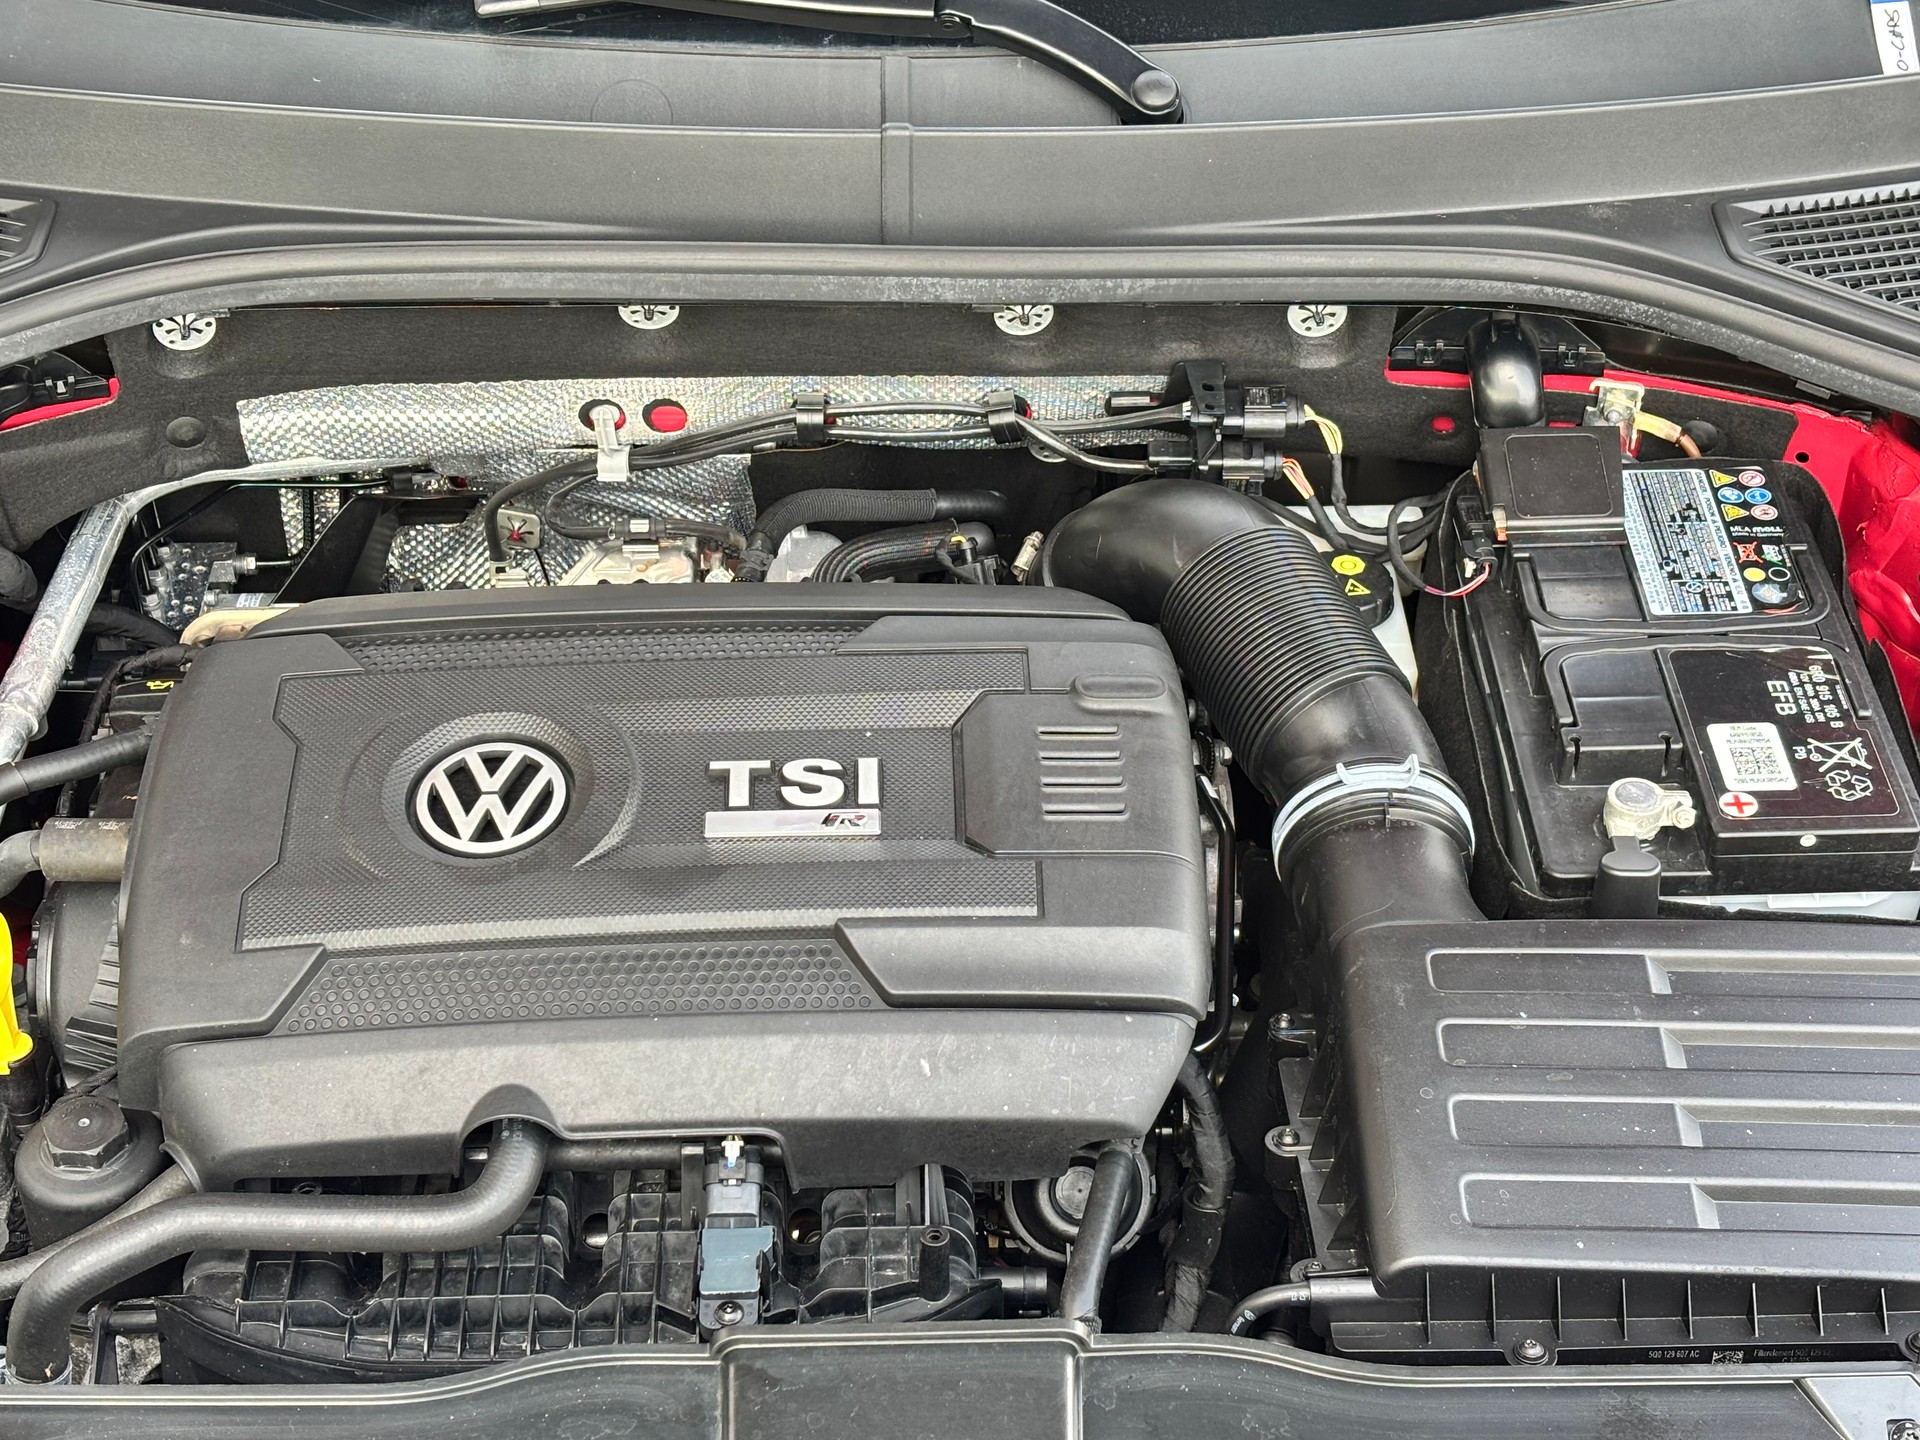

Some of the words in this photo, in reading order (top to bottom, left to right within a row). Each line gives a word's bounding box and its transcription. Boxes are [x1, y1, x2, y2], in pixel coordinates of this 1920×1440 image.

[1766, 680, 1798, 716] EFB
[1815, 685, 1834, 700] 915
[1823, 704, 1841, 718] 105
[708, 757, 881, 808] TSI
[1689, 1350, 1700, 1358] AC
